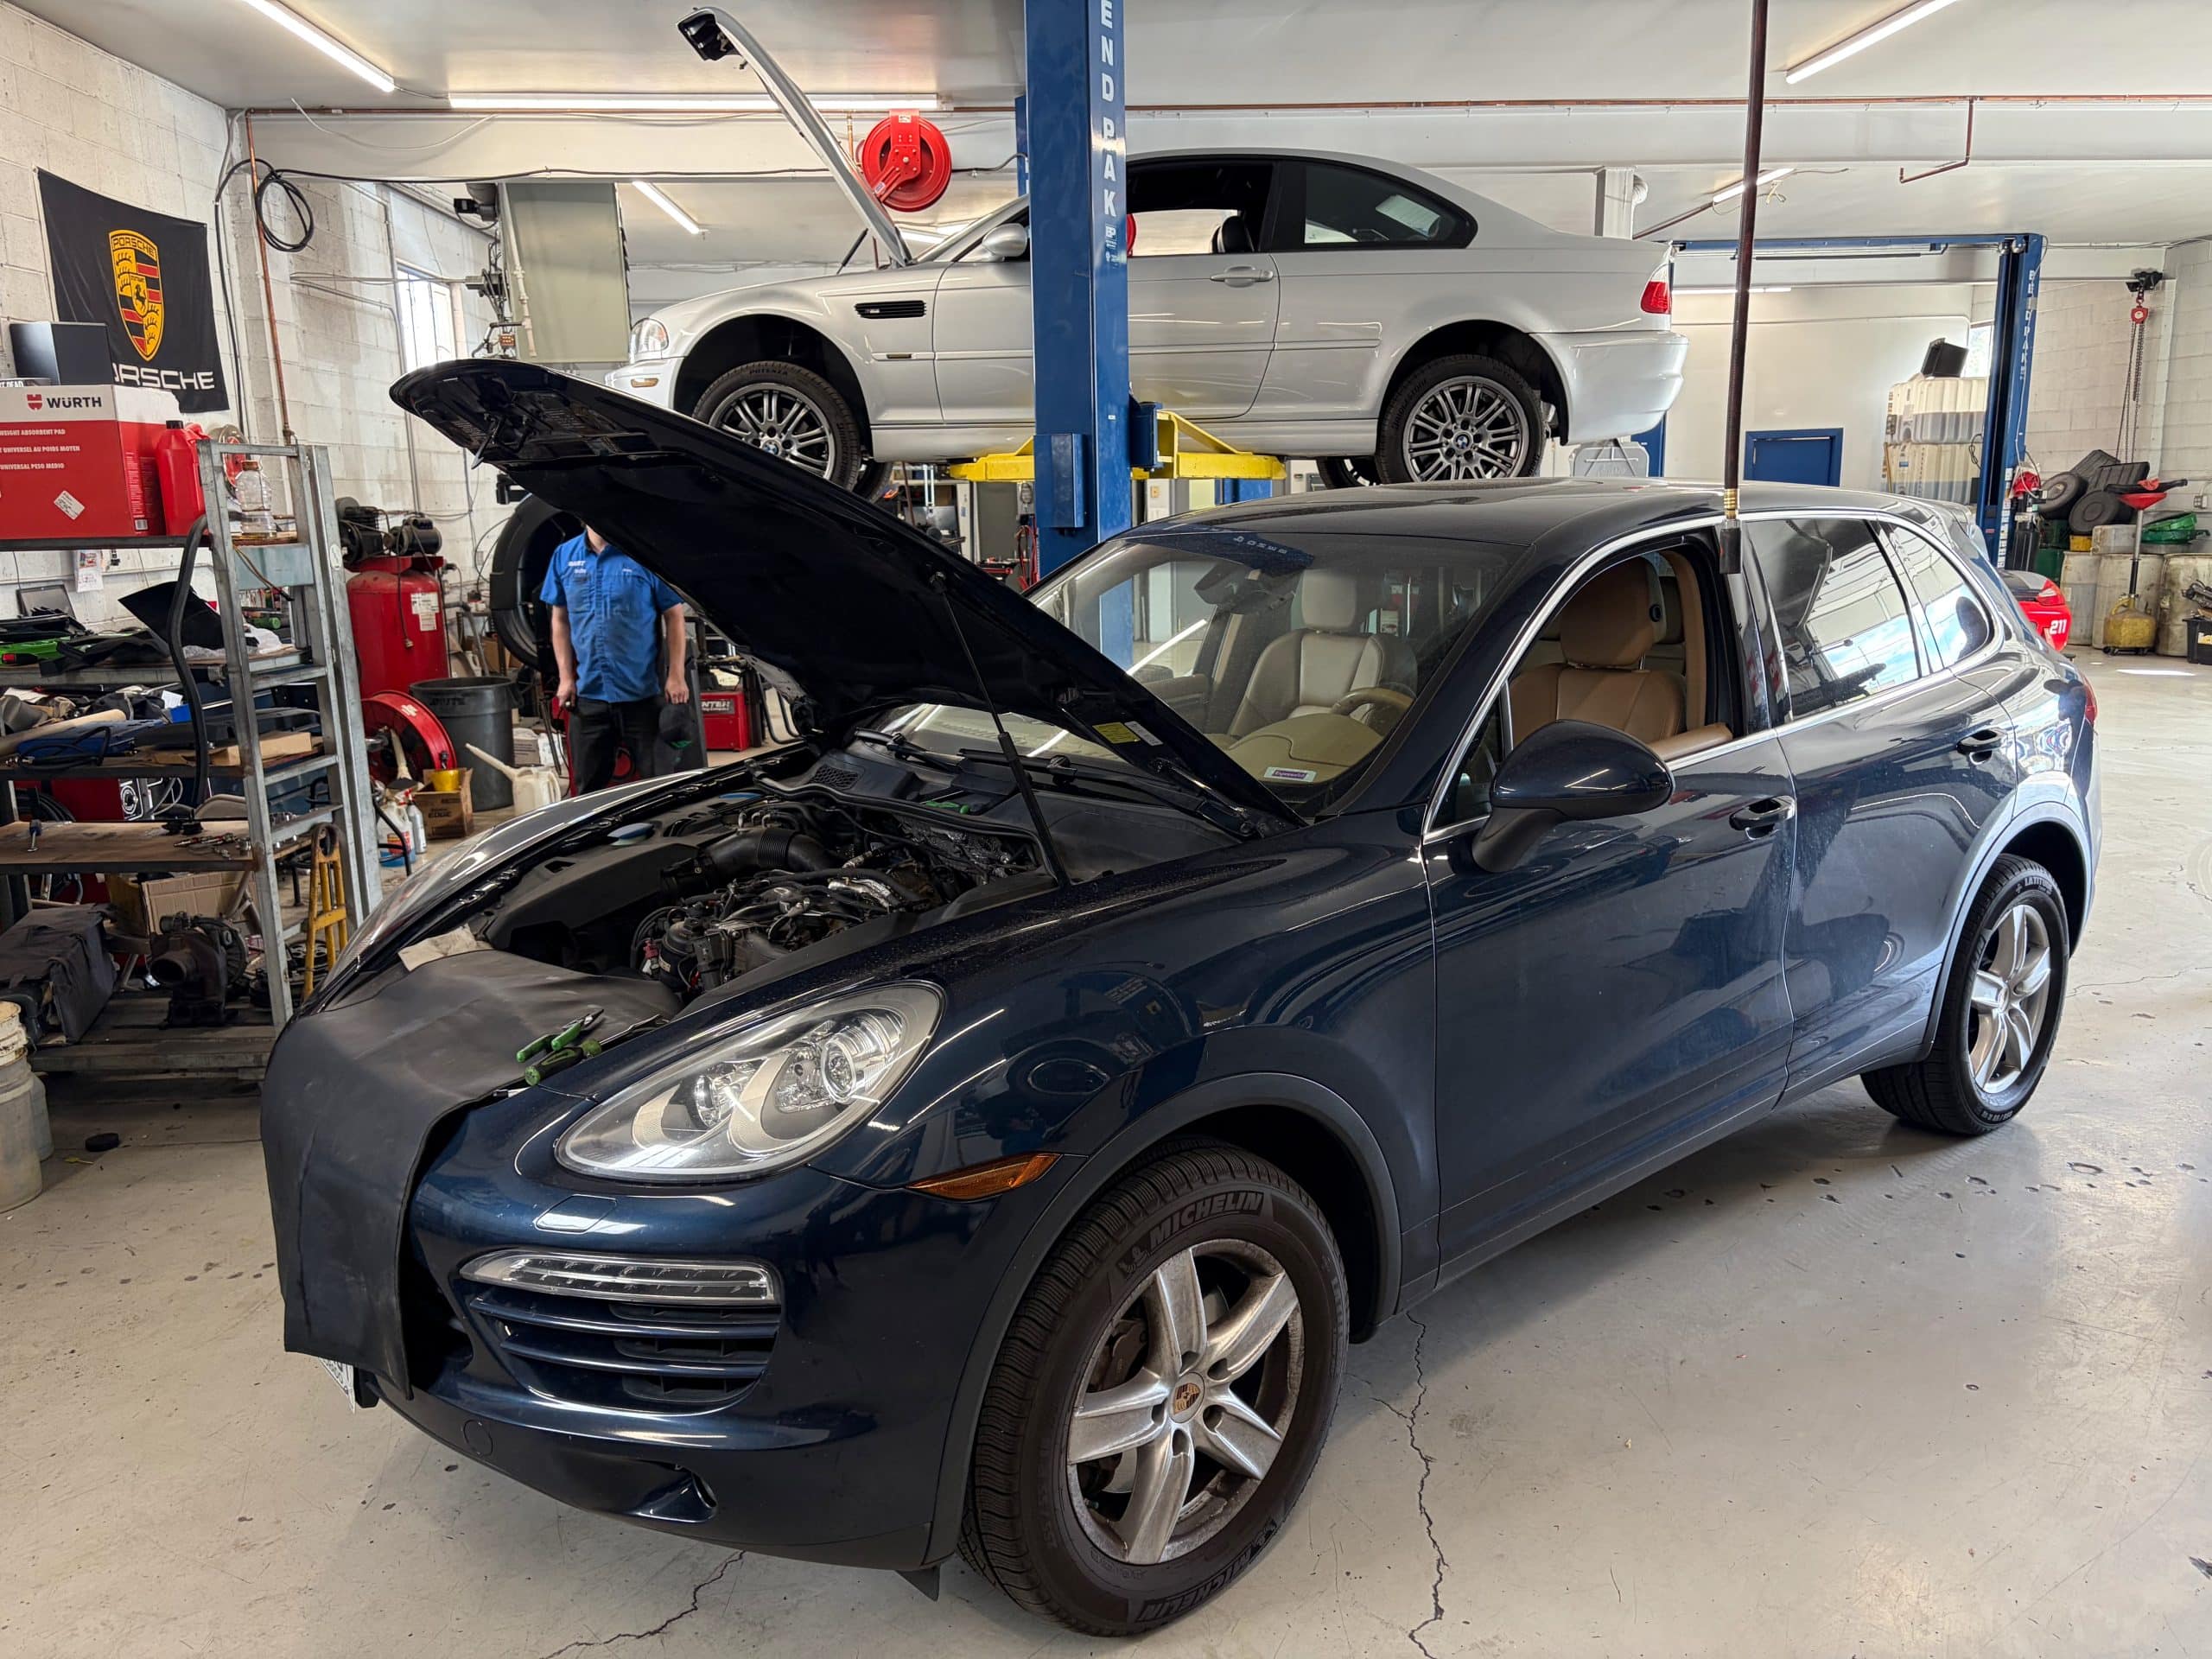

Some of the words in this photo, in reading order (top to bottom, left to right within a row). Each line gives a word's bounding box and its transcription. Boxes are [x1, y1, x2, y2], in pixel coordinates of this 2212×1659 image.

[112, 237, 156, 257] PORSCHE
[113, 363, 215, 390] RSCHE
[47, 397, 102, 408] WÜRTH
[2049, 619, 2068, 635] 211
[1132, 1191, 1264, 1248] MICHELIN
